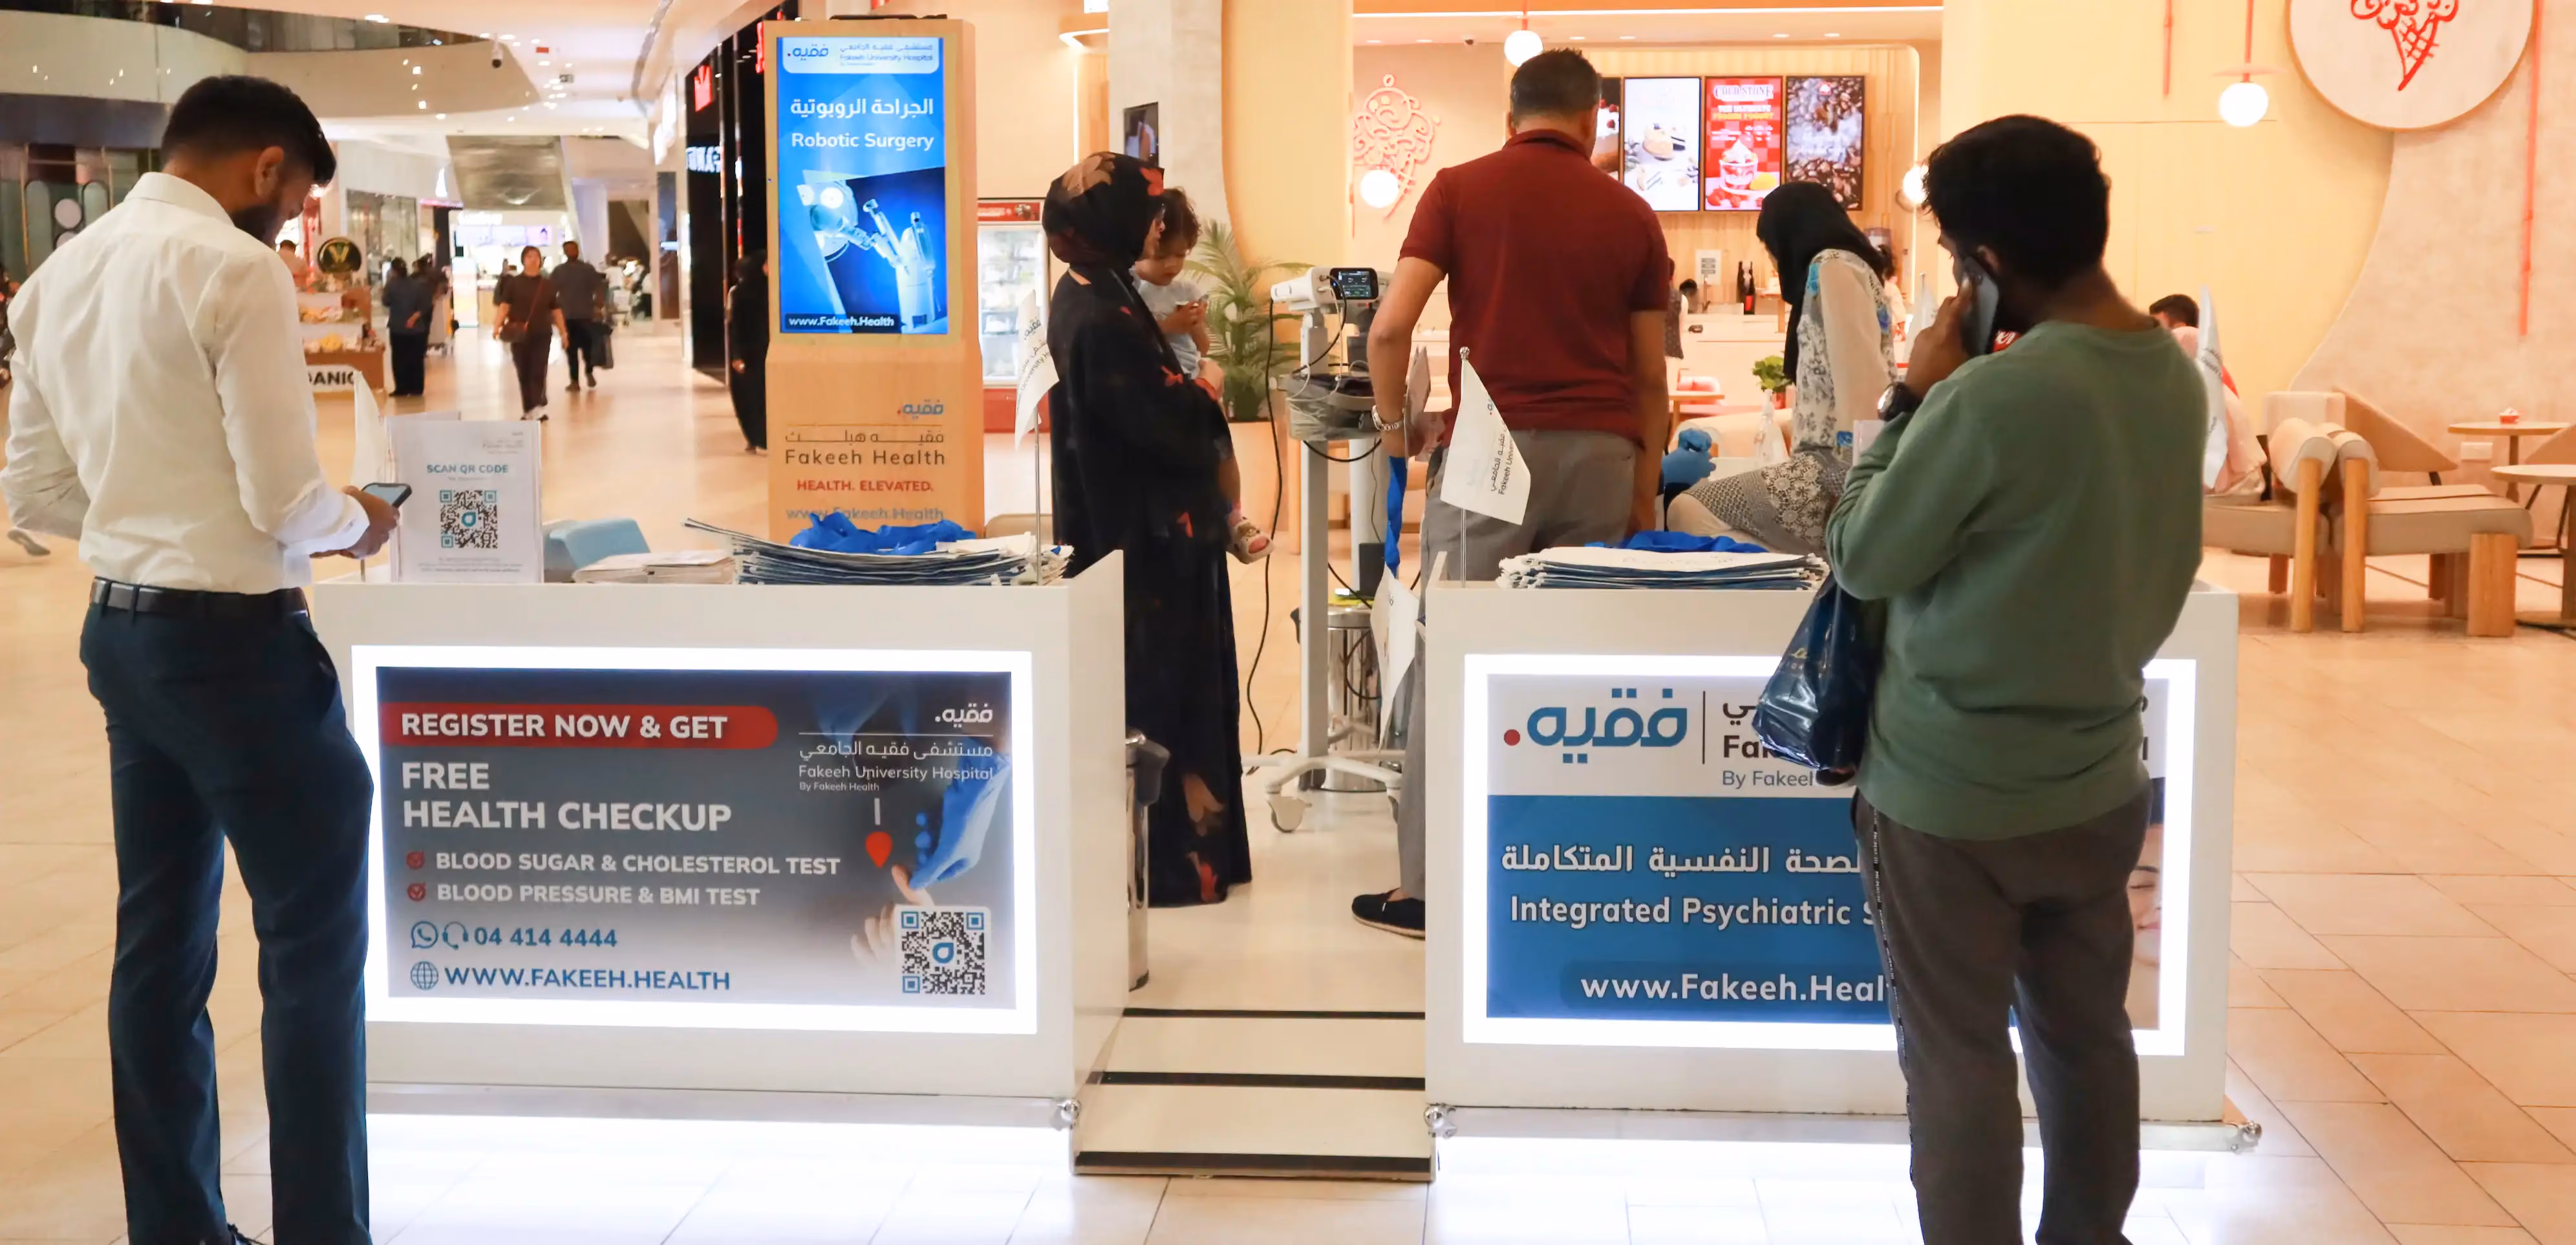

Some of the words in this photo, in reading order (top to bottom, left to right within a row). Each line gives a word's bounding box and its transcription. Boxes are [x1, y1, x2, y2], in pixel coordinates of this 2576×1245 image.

[790, 98, 866, 119] الروبوتية
[872, 98, 934, 119] الجراحة
[791, 132, 860, 148] Robotic
[864, 133, 934, 151] Surgery
[788, 316, 895, 327] www.Fakeeh.Health
[785, 450, 863, 464] Fakeeh
[872, 450, 945, 464] Health
[427, 464, 456, 473] SCAN
[460, 464, 475, 475] QR
[479, 464, 508, 473] CODE
[797, 481, 855, 492] HEALTH.
[859, 481, 934, 492] ELEVATED.
[1497, 466, 1511, 495] Fakeeh
[402, 713, 544, 738] REGISTER
[554, 715, 630, 738] NOW
[639, 716, 661, 738] &
[669, 716, 728, 739] GET
[800, 741, 861, 761] الجامعي
[866, 742, 909, 759] فقيه
[914, 743, 993, 759] مستشفى
[402, 763, 490, 790] FREE
[799, 765, 850, 779] Fakeeh
[855, 766, 928, 782] University
[932, 767, 993, 781] Hospital
[1723, 770, 1746, 789] By
[799, 783, 811, 792] By
[813, 783, 846, 791] Fakeeh
[849, 783, 879, 792] Health
[403, 801, 546, 829] HEALTH
[557, 803, 732, 832] CHECKUP
[436, 853, 511, 870] BLOOD
[519, 854, 595, 871] SUGAR
[601, 854, 617, 872] &
[623, 856, 780, 873] CHOLESTEROL
[786, 858, 841, 874] TEST
[1502, 845, 1633, 871] المتكاملة
[1649, 847, 1769, 878] النفسية
[437, 885, 513, 902] BLOOD
[520, 885, 632, 904] PRESSURE
[638, 887, 654, 904] &
[660, 888, 699, 905] BMI
[706, 888, 760, 906] TEST
[1511, 896, 1670, 929] Integrated
[1682, 898, 1851, 930] Psychiatric
[475, 929, 502, 945] 04
[510, 929, 551, 946] 414
[560, 929, 617, 947] 4444
[444, 968, 730, 990] WWW.FAKEEH.HEALTH
